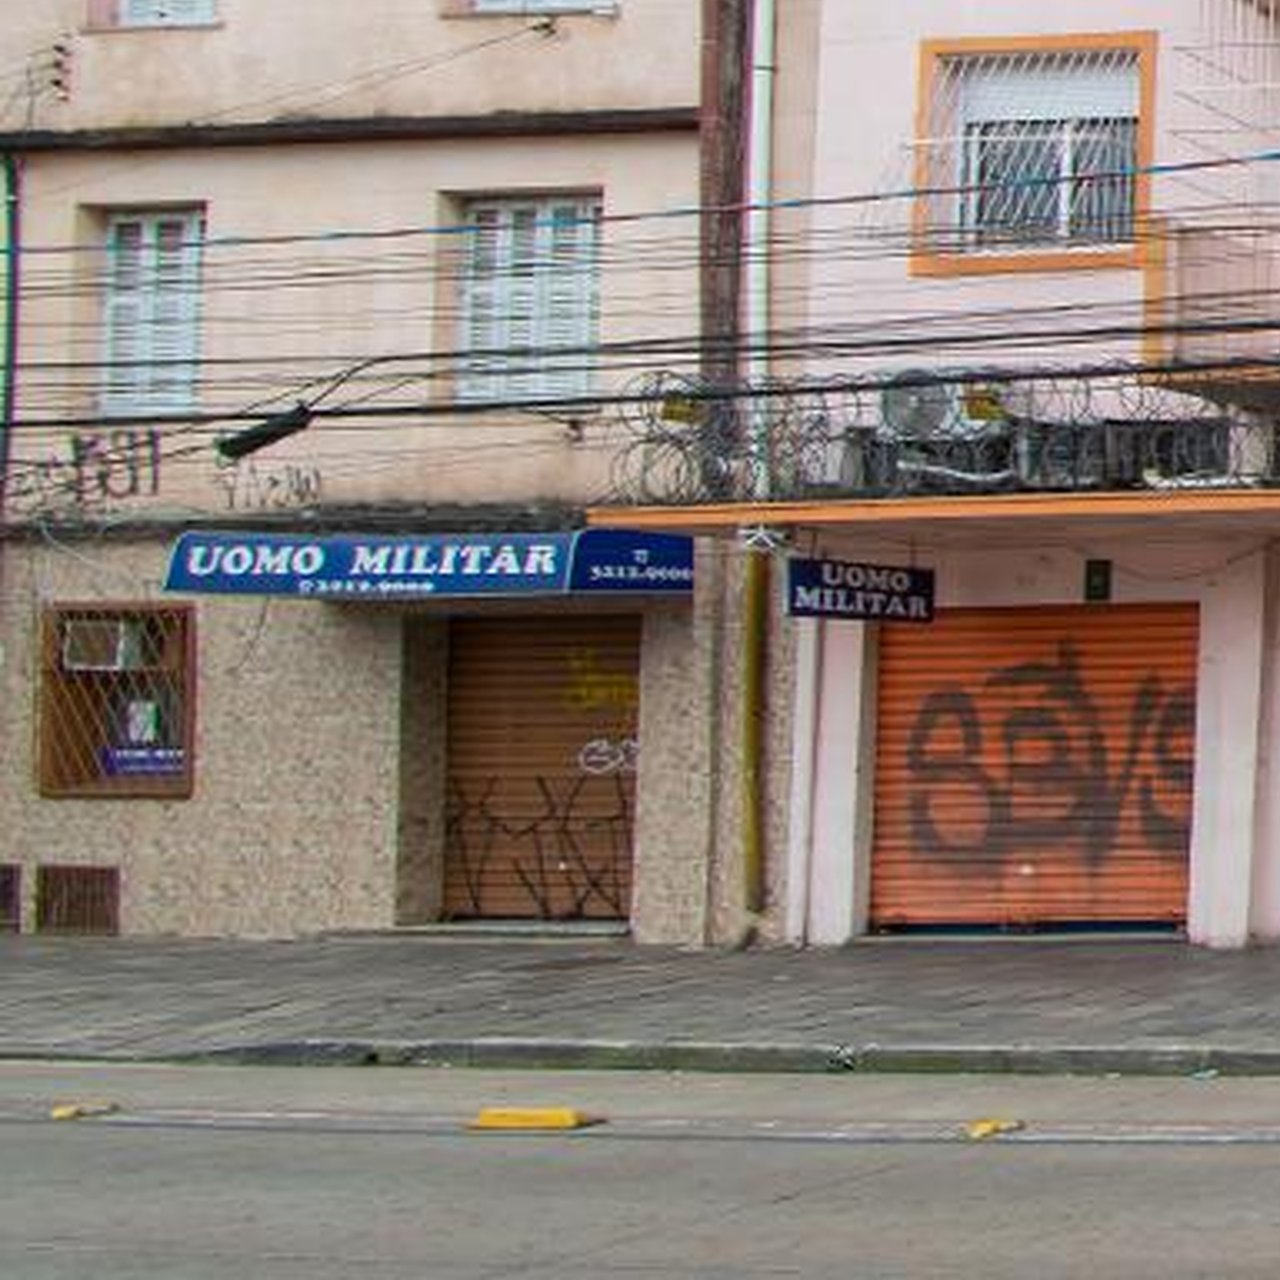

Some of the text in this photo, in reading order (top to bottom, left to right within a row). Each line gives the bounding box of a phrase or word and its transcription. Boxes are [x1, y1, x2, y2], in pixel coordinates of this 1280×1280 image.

[187, 545, 557, 576] UOMO MILITAR
[821, 562, 911, 592] UOMO
[793, 586, 929, 618] MILITAR
